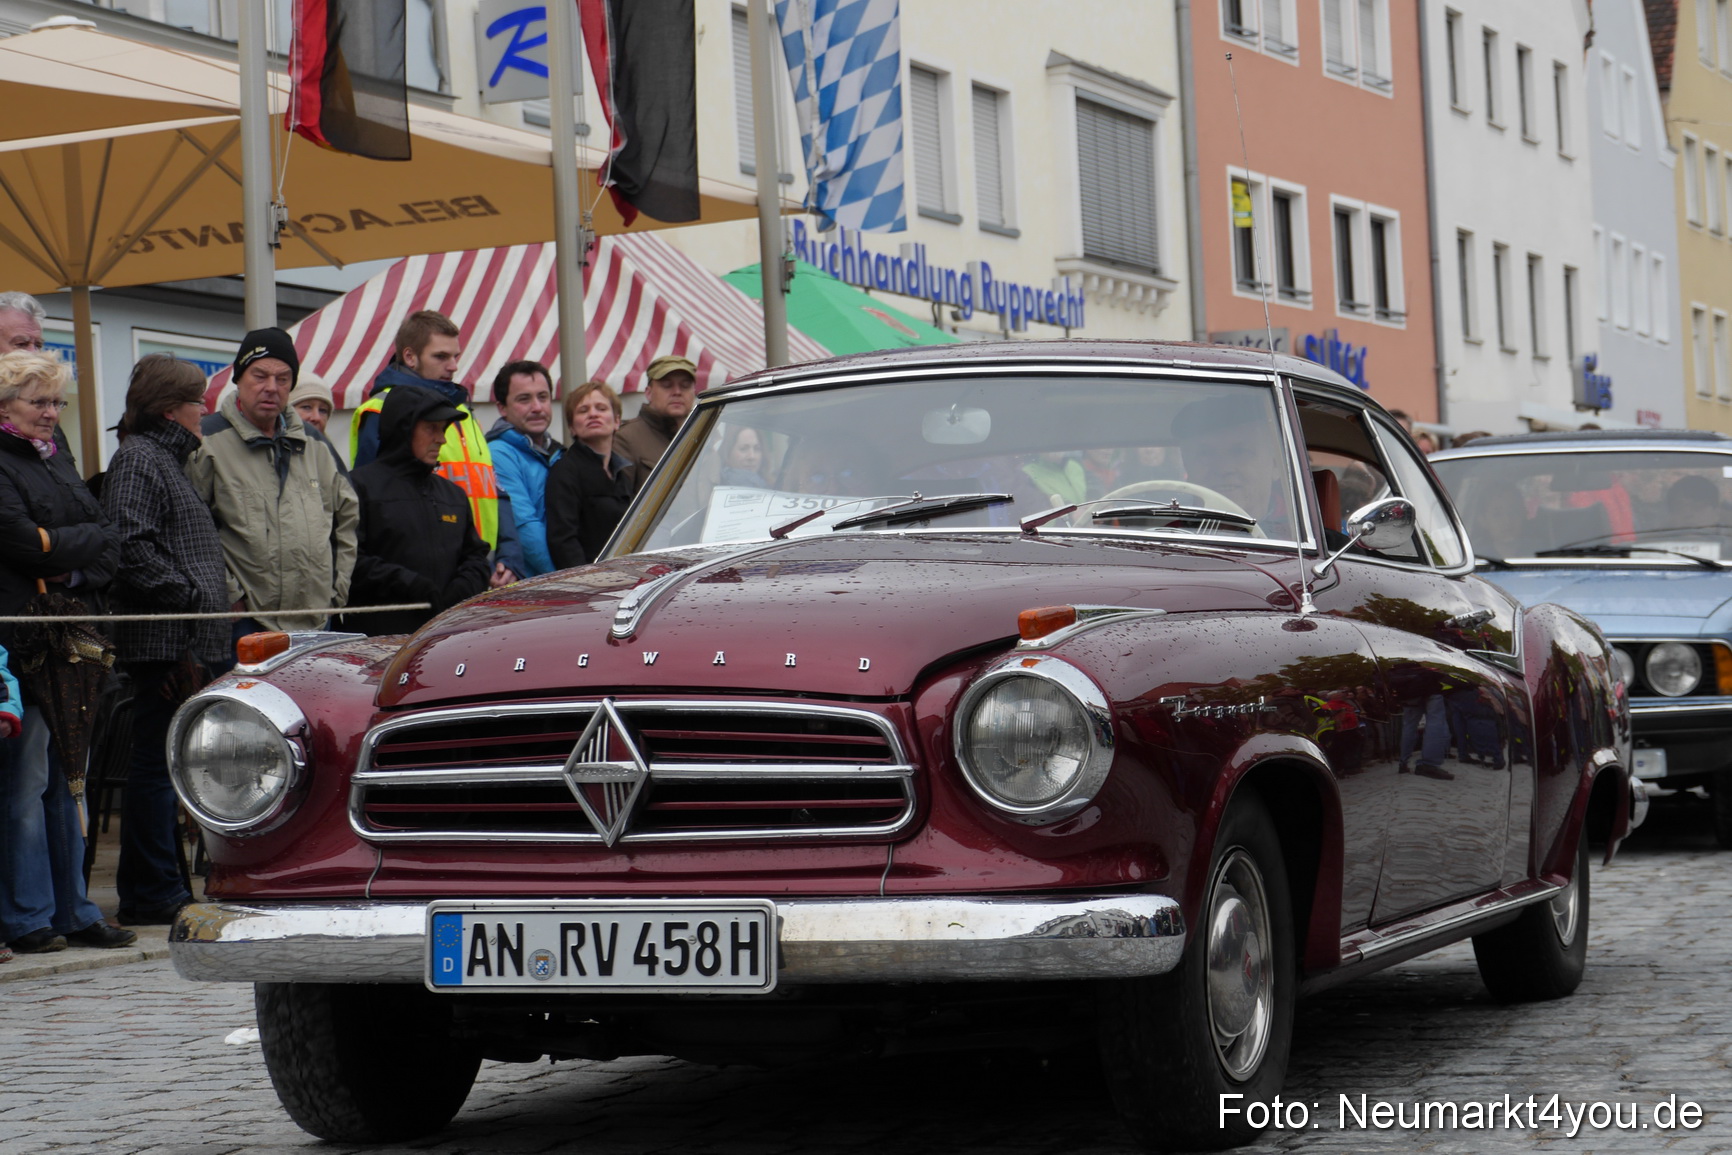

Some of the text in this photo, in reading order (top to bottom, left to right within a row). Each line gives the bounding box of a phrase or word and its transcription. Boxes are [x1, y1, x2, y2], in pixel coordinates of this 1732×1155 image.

[794, 219, 1084, 332] Buchhandlung Rupprecht
[782, 497, 838, 510] 350
[398, 651, 870, 685] BORGWARD
[443, 957, 454, 972] D
[466, 922, 524, 977] AN
[560, 922, 619, 977] RV
[633, 920, 759, 977] 458H
